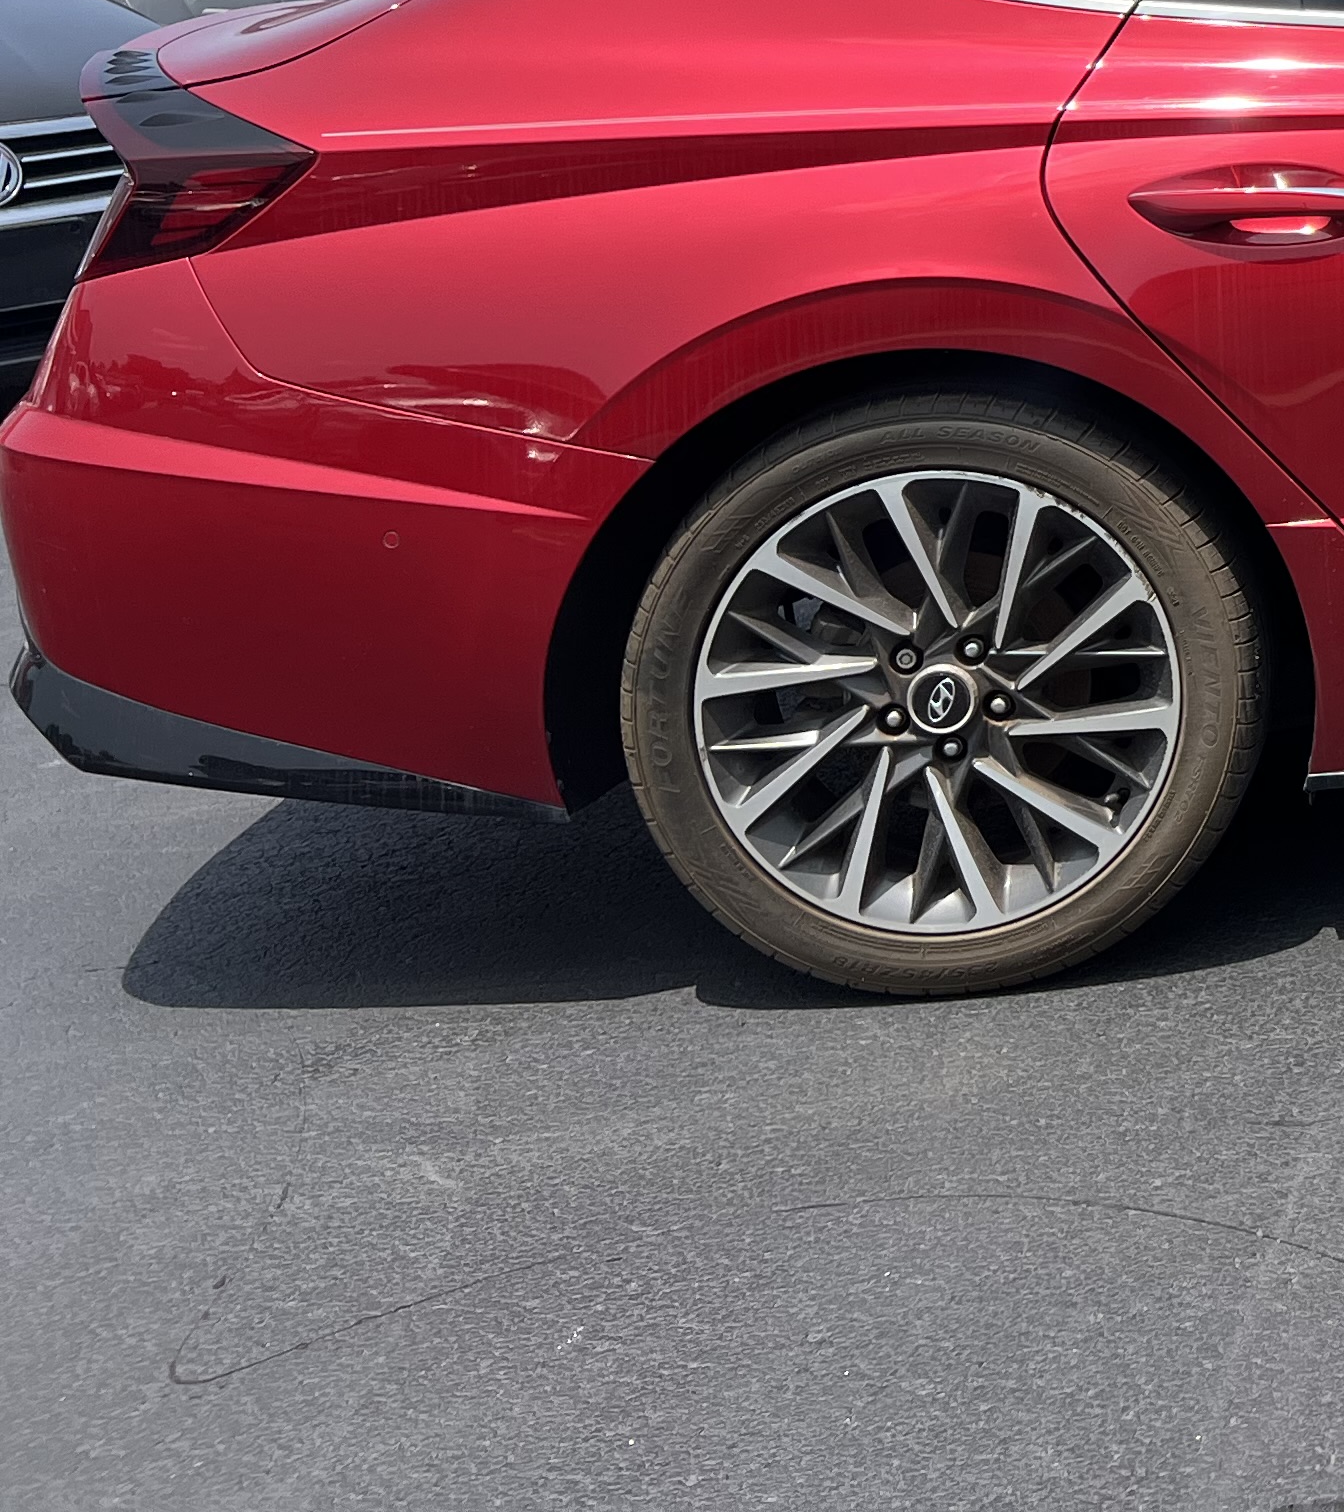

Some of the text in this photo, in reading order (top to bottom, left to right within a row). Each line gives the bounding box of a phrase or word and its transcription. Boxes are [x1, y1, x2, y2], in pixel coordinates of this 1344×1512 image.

[879, 425, 1042, 453] ALL SEASON
[1192, 605, 1222, 748] VIENTO
